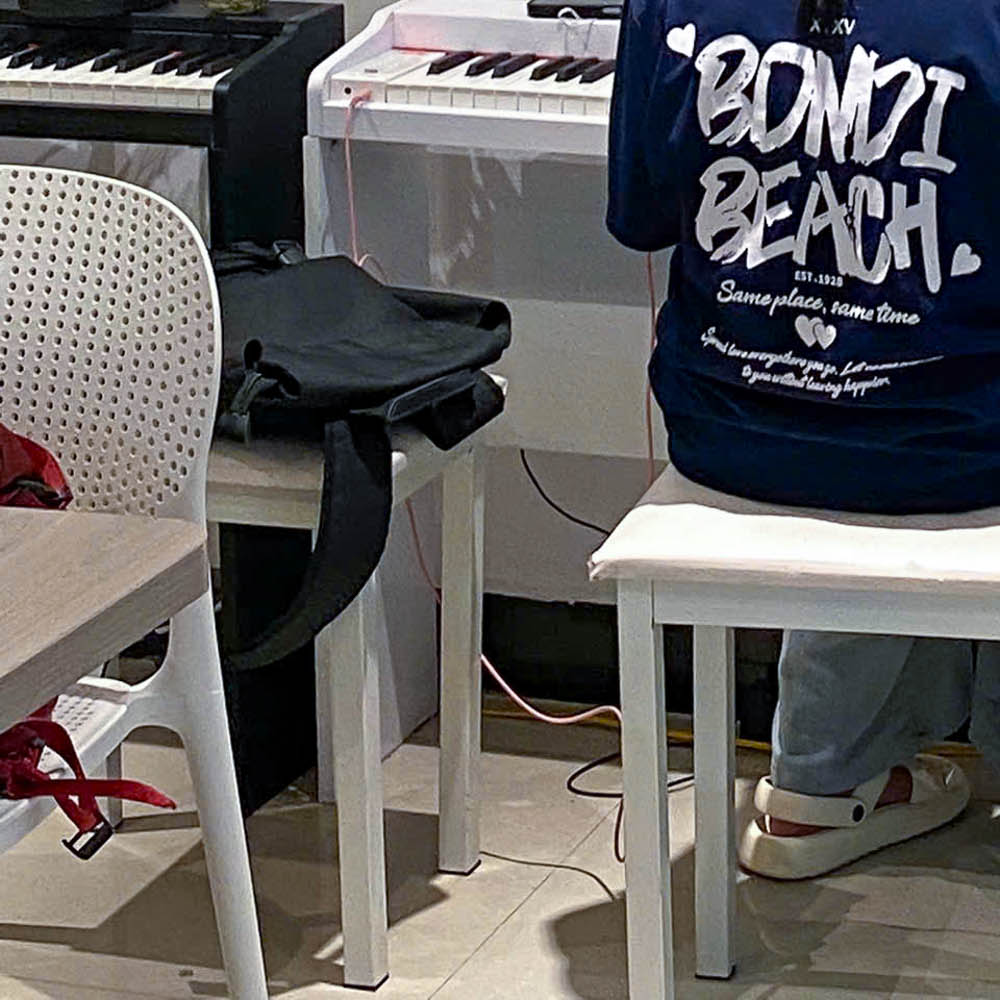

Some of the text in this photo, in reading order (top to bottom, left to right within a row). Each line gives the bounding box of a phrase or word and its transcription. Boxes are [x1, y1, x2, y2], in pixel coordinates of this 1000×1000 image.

[695, 34, 966, 174] BONDI
[695, 156, 943, 295] BEACH
[716, 279, 771, 307] Same
[830, 300, 873, 323] same
[876, 302, 921, 326] time
